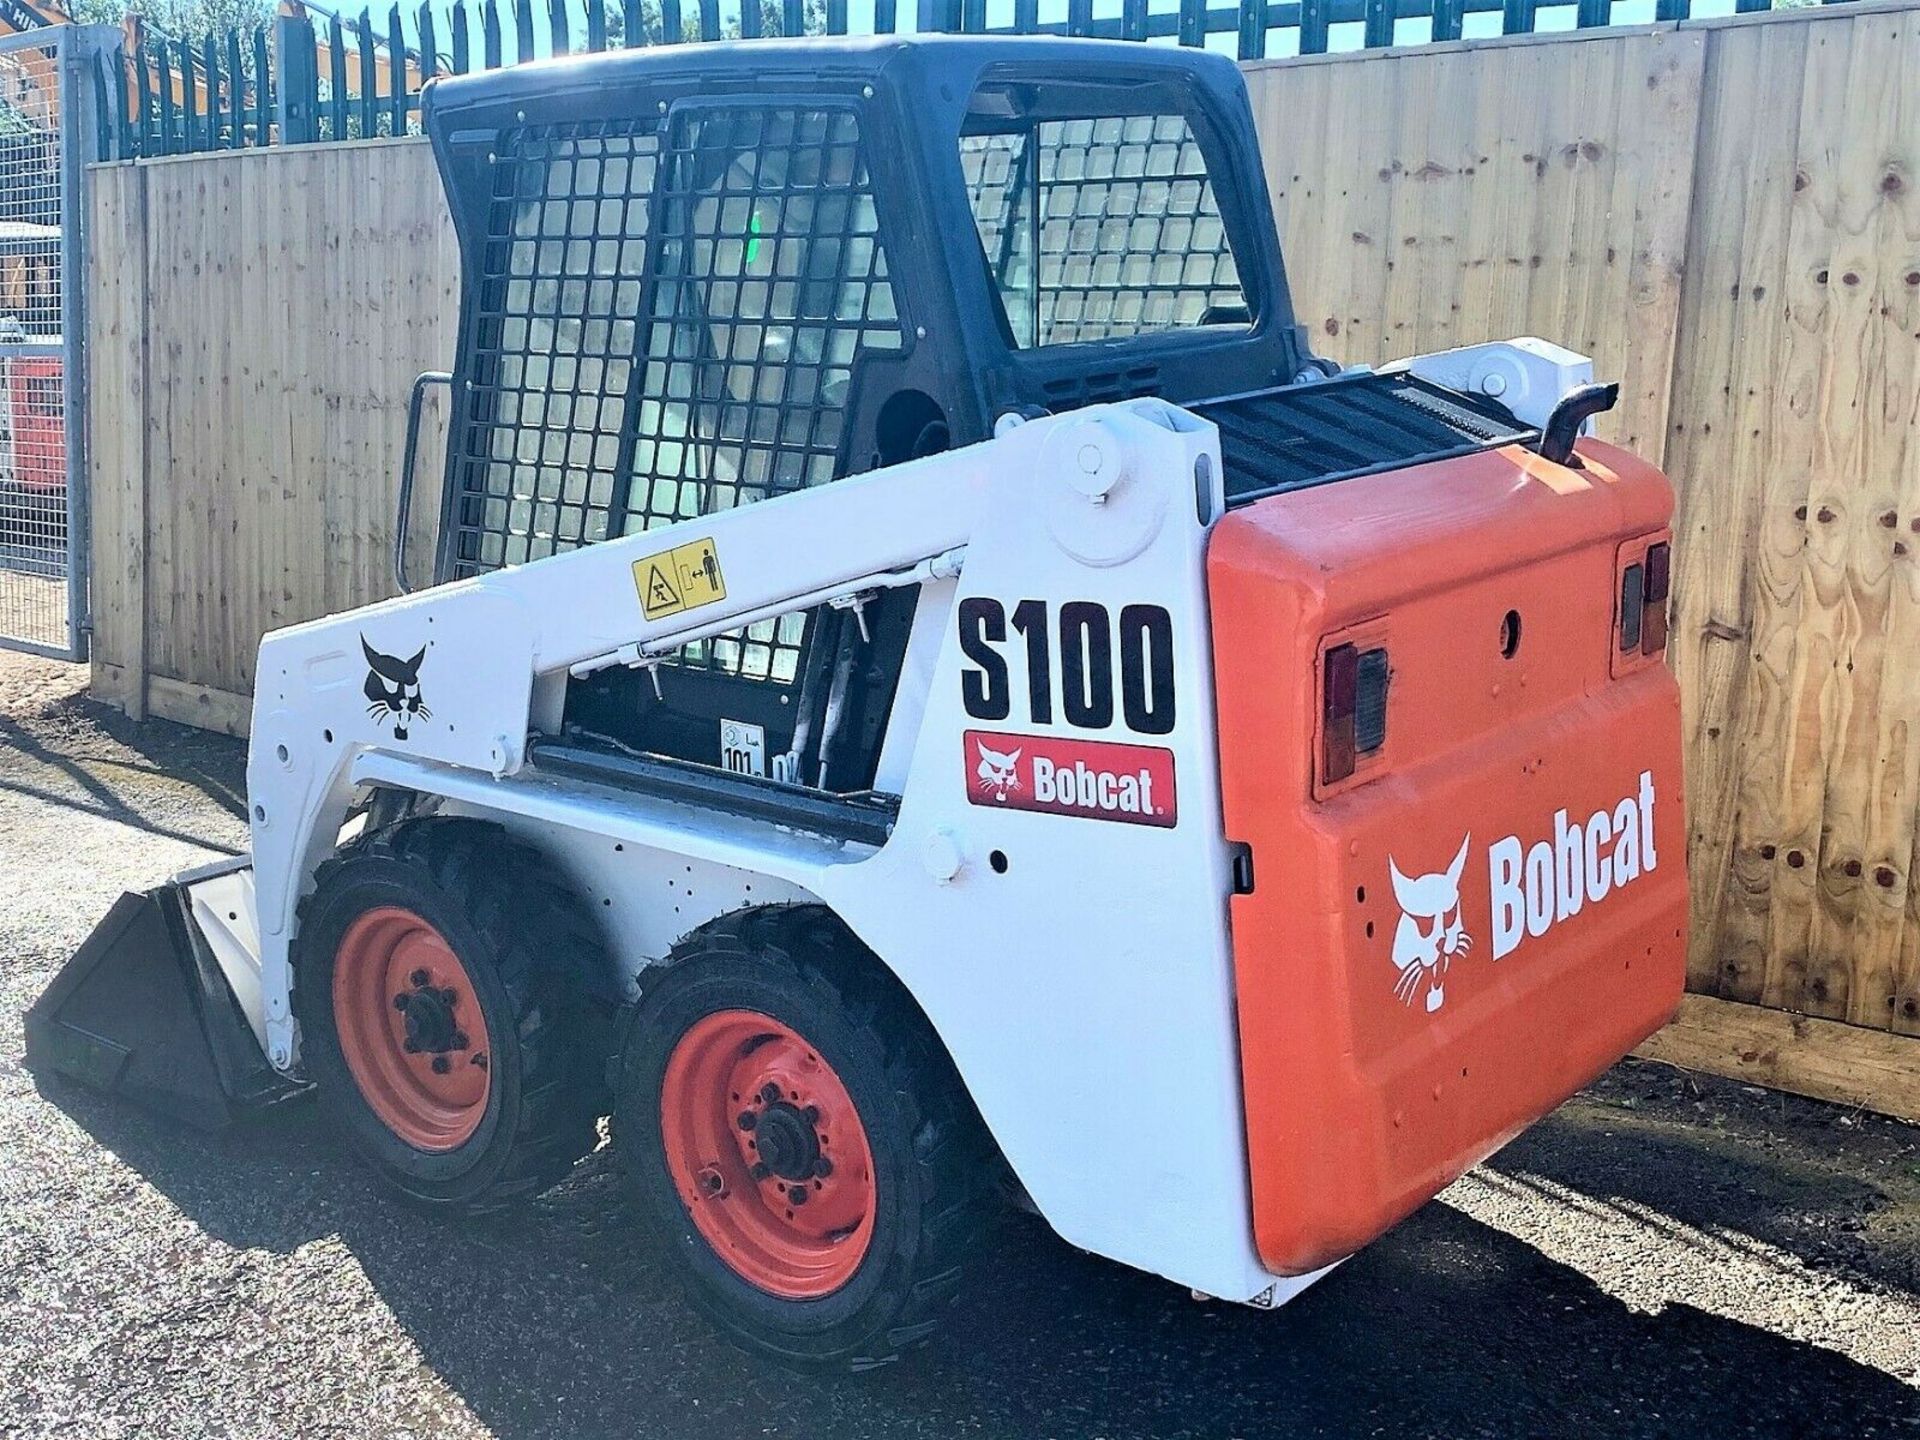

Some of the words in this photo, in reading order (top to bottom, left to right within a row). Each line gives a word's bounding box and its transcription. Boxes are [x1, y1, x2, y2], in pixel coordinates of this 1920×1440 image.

[959, 597, 1176, 735] S100
[724, 747, 751, 774] 101
[1032, 756, 1154, 815] Bobcat
[1489, 769, 1657, 961] Bobcat
